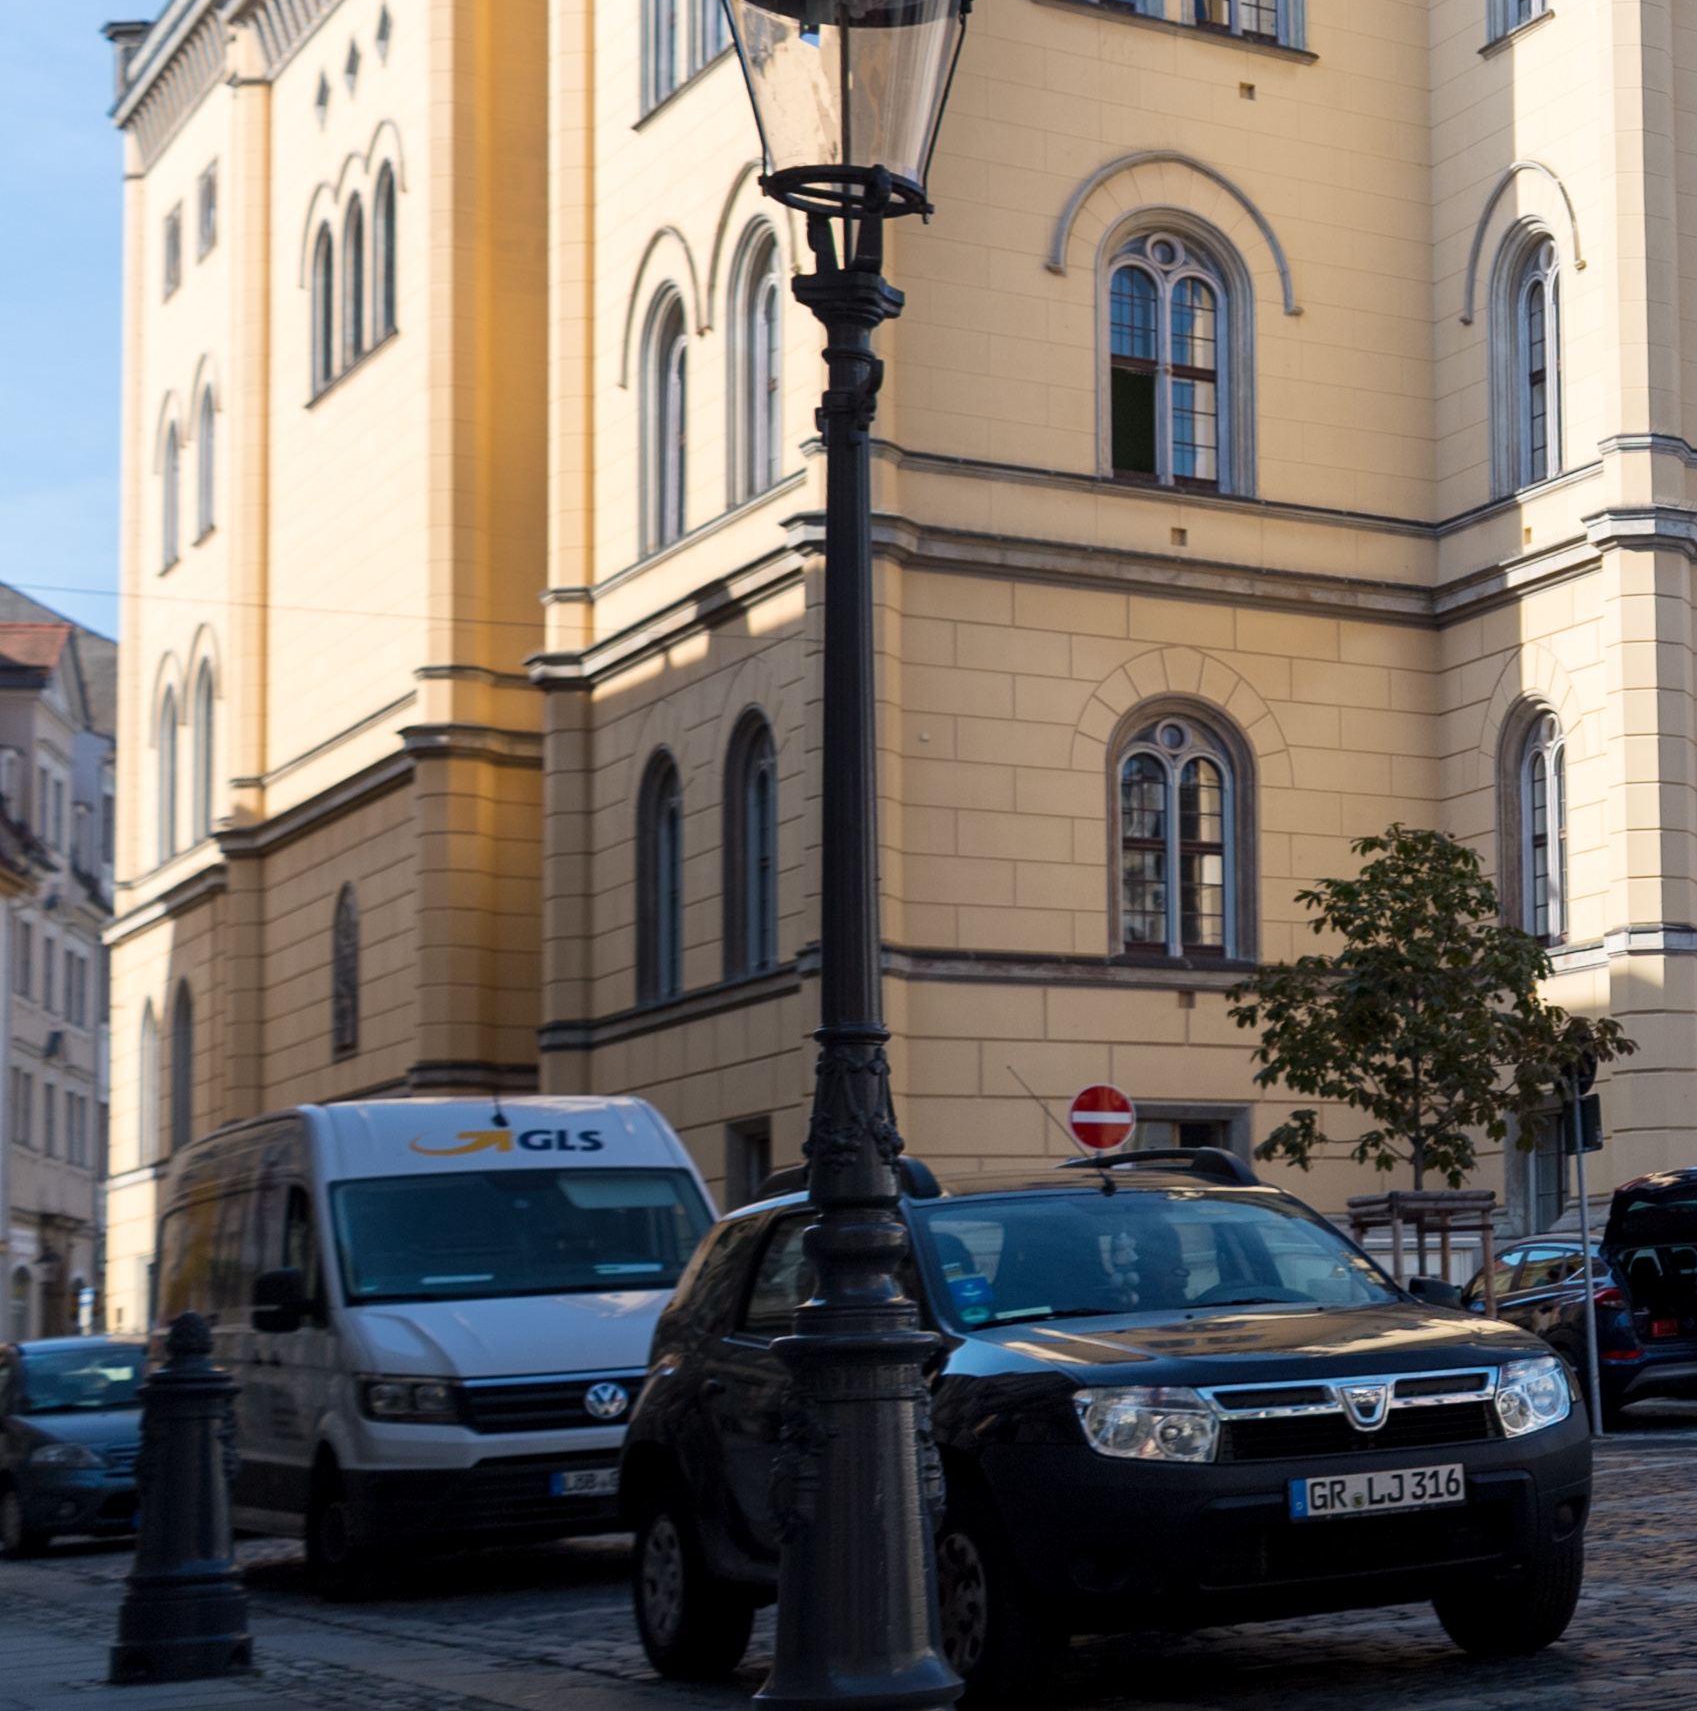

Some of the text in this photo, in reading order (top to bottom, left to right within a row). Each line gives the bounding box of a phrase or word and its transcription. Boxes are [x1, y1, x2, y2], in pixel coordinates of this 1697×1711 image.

[518, 1129, 604, 1152] GLS
[1309, 1468, 1461, 1510] GR LJ 316
